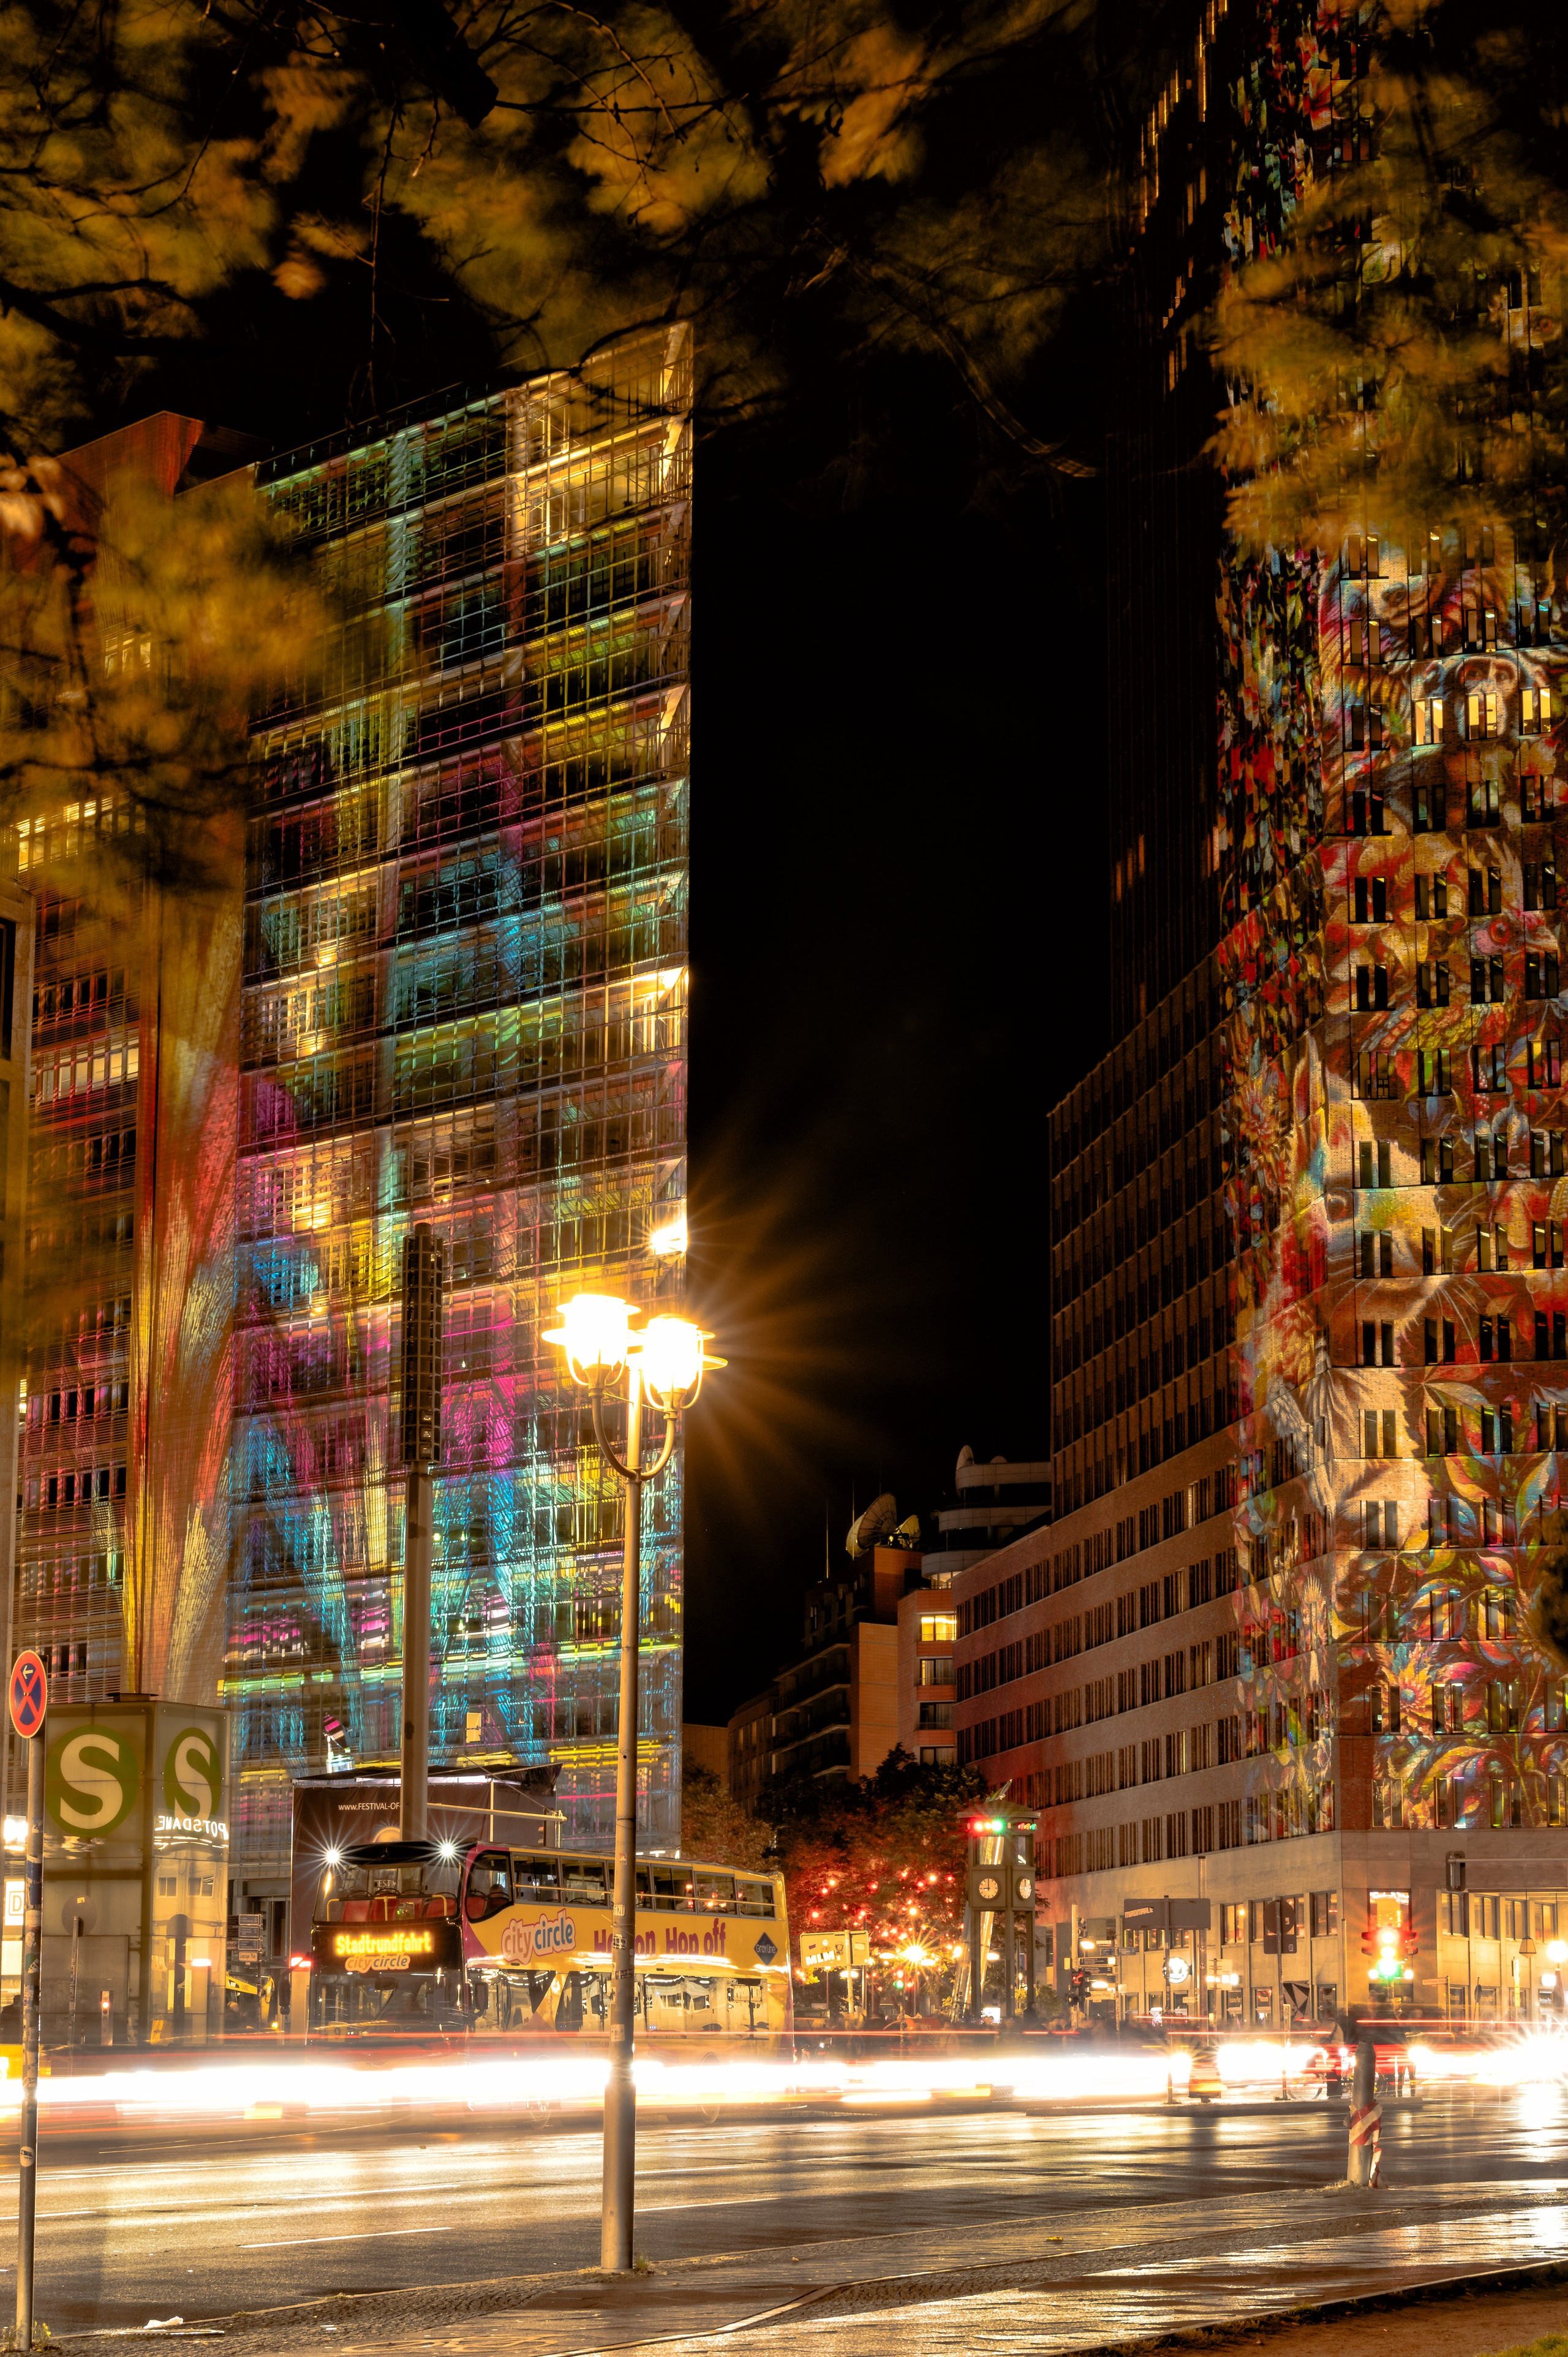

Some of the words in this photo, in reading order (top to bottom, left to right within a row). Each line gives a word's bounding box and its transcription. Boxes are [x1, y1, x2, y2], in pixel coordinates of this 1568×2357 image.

[60, 1734, 123, 1829] S
[174, 1736, 213, 1820] S
[12, 1895, 22, 1912] D
[336, 1932, 431, 1955] Stadtrundfahrt
[504, 1926, 532, 1958] city
[534, 1917, 573, 1950] circle
[703, 1917, 726, 1957] off
[347, 1955, 372, 1970] city
[373, 1954, 408, 1968] circle
[805, 1950, 835, 1966] MLM
